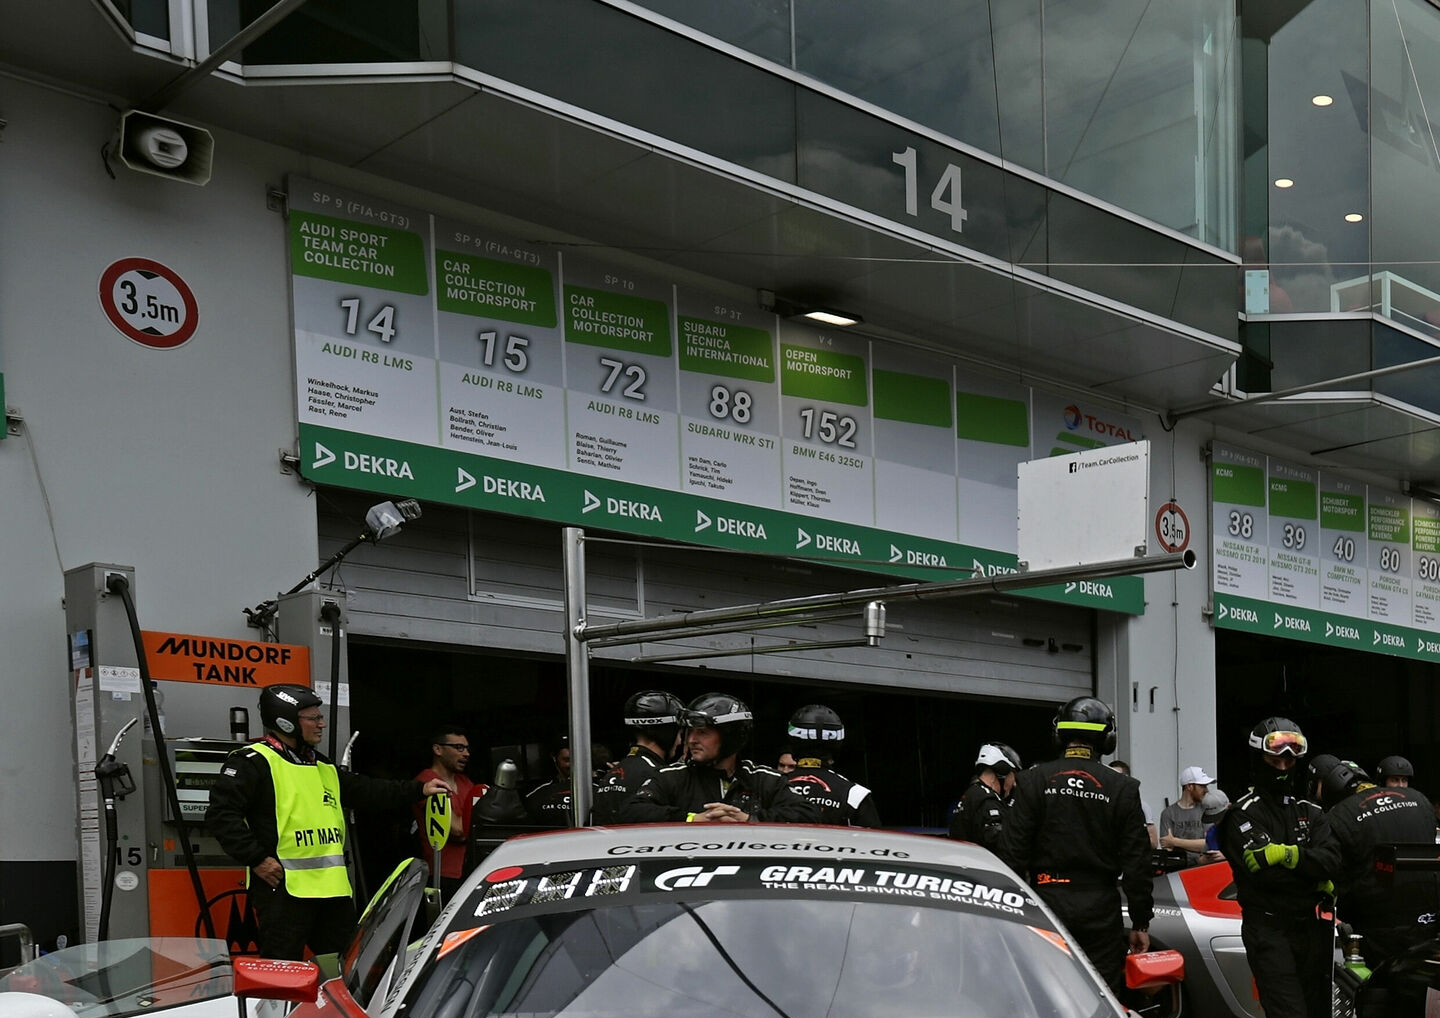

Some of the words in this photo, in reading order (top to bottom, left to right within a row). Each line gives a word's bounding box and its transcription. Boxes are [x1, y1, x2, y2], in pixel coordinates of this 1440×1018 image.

[892, 146, 967, 233] 14
[313, 192, 330, 205] SP
[335, 198, 343, 208] 9
[347, 201, 410, 229] (FIA-GT3)
[300, 221, 336, 239] AUDI
[340, 228, 388, 247] SPORT
[302, 235, 344, 254] TEAM
[348, 245, 378, 260] CAR
[304, 251, 395, 278] COLLECTION
[443, 259, 471, 275] CAR
[445, 274, 526, 297] COLLECTION
[120, 279, 180, 326] 3,5m
[446, 287, 537, 313] MOTORSPORT
[570, 294, 595, 308] CAR
[340, 297, 397, 344] 14
[571, 307, 644, 329] COLLECTION
[684, 321, 726, 338] SUBARU
[573, 320, 654, 343] MOTORSPORT
[685, 334, 731, 350] TECNICA
[321, 342, 357, 359] AUDI
[361, 350, 379, 364] R8
[383, 355, 414, 372] LMS
[479, 331, 529, 373] 15
[686, 347, 769, 369] INTERNATIONAL
[785, 348, 818, 364] OEPEN
[599, 358, 647, 401] 72
[786, 360, 852, 380] MOTORSPORT
[307, 377, 351, 393] Winkelhock,
[352, 387, 379, 398] Markus
[307, 387, 333, 399] Haase,
[334, 392, 376, 406] Christopher
[461, 372, 493, 389] AUDI
[497, 381, 513, 394] R8
[516, 385, 543, 400] LMS
[308, 405, 327, 416] Rast,
[329, 409, 347, 418] Rene
[337, 402, 362, 412] Marcel
[587, 401, 615, 416] AUDI
[618, 407, 633, 419] R8
[636, 411, 660, 425] LMS
[709, 384, 752, 424] 88
[687, 422, 730, 440] SUBARU
[733, 433, 755, 446] WRX
[758, 437, 775, 450] STI
[800, 407, 857, 449] 152
[1085, 414, 1137, 442] TOTAL
[344, 451, 415, 480] DEKRA
[792, 445, 817, 459] BMW
[818, 451, 836, 464] E46
[837, 455, 864, 470] 325CI
[1215, 467, 1234, 478] KCMG
[483, 475, 546, 503] DEKRA
[1271, 483, 1288, 493] KCMG
[607, 497, 663, 523] DEKRA
[717, 516, 767, 541] DEKRA
[1228, 510, 1254, 539] 38
[816, 534, 862, 556] DEKRA
[1283, 524, 1305, 550] 39
[1333, 536, 1355, 562] 40
[907, 550, 947, 567] DEKRA
[1380, 547, 1400, 572] 80
[1080, 580, 1113, 598] DEKRA
[1230, 607, 1258, 624] DEKRA
[1285, 616, 1311, 632] DEKRA
[156, 637, 292, 666] MUNDORF
[193, 662, 257, 686] TANK
[1067, 777, 1085, 789] CC
[1060, 788, 1110, 803] COLLECTION
[1376, 796, 1393, 806] CC
[1356, 811, 1373, 822] CAR
[1374, 800, 1418, 814] COLLECTION
[295, 830, 315, 848] PIT
[607, 841, 910, 860] CarCollection.de
[474, 865, 636, 919] 24H
[760, 865, 864, 884] GRAN
[874, 869, 1025, 908] TURISMO
[762, 882, 798, 890] THE
[803, 882, 850, 892] REAL
[852, 884, 926, 898] DRIVING
[929, 891, 1025, 916] SIMULATOR
